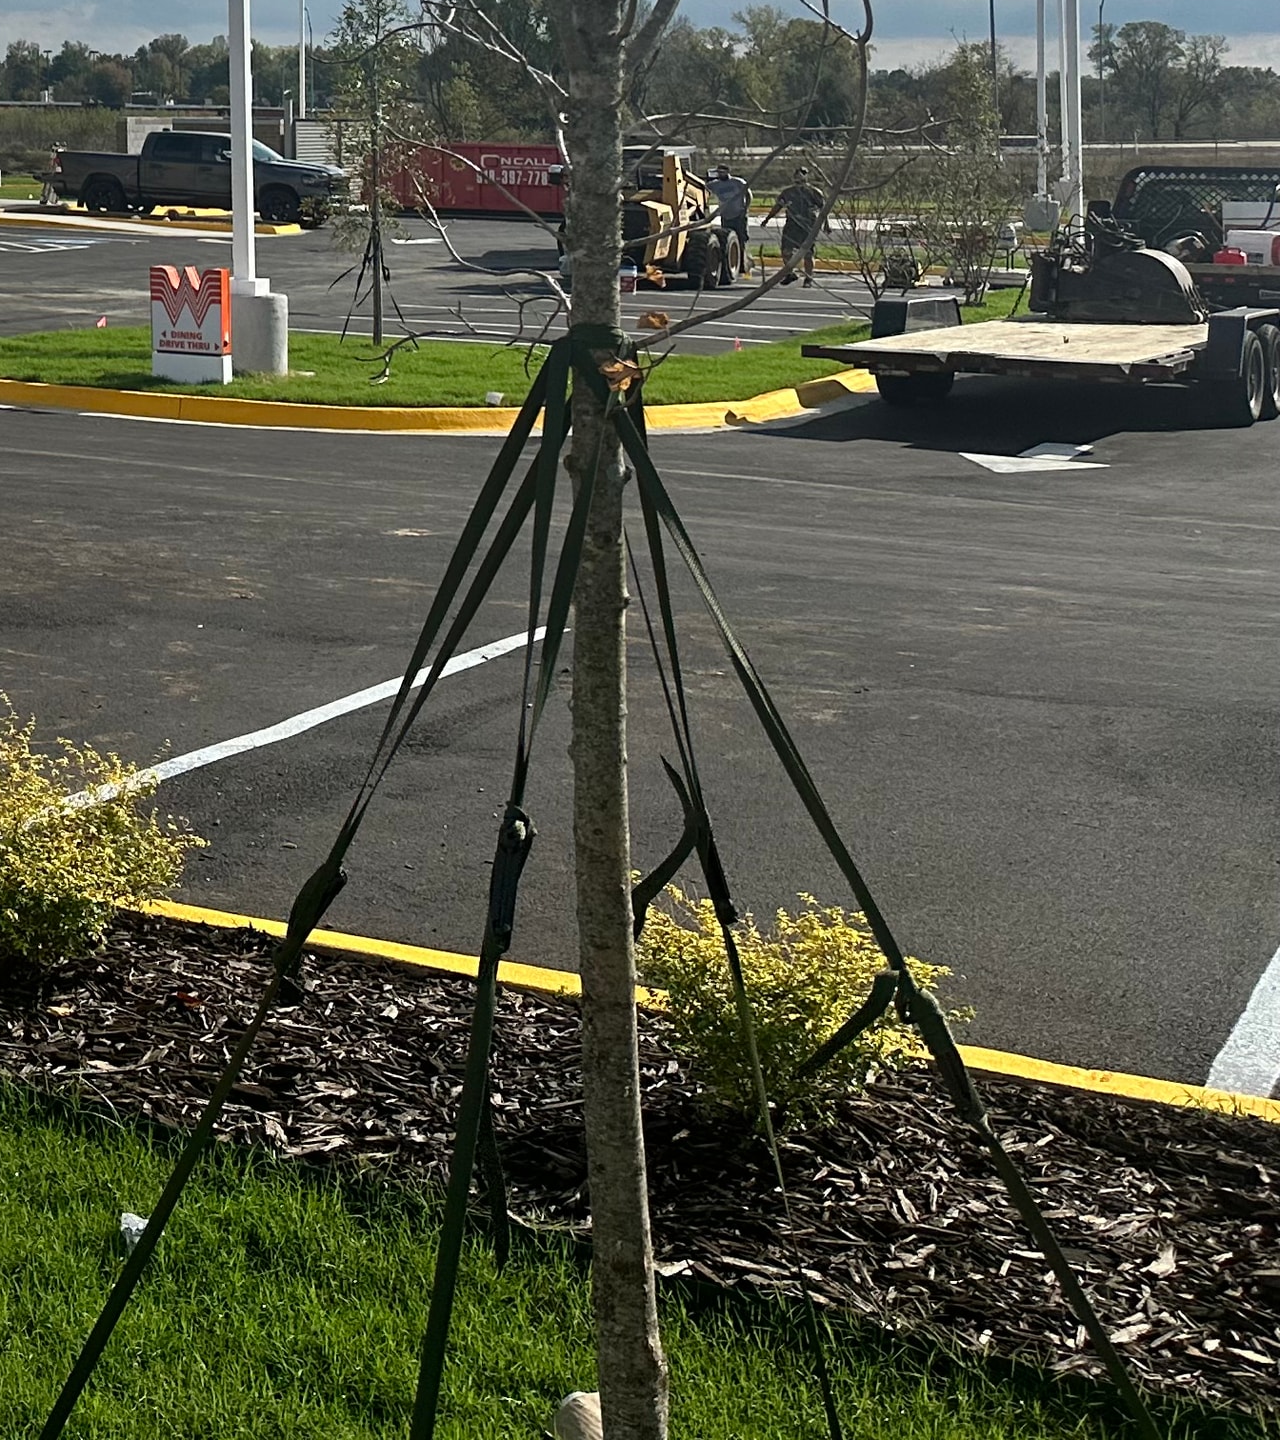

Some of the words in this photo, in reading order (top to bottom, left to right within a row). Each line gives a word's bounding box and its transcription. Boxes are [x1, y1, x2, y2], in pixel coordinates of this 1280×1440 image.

[476, 169, 548, 186] 918-397-778
[170, 331, 203, 341] DINING
[159, 340, 186, 349] DRIVE
[187, 341, 210, 351] THRU
